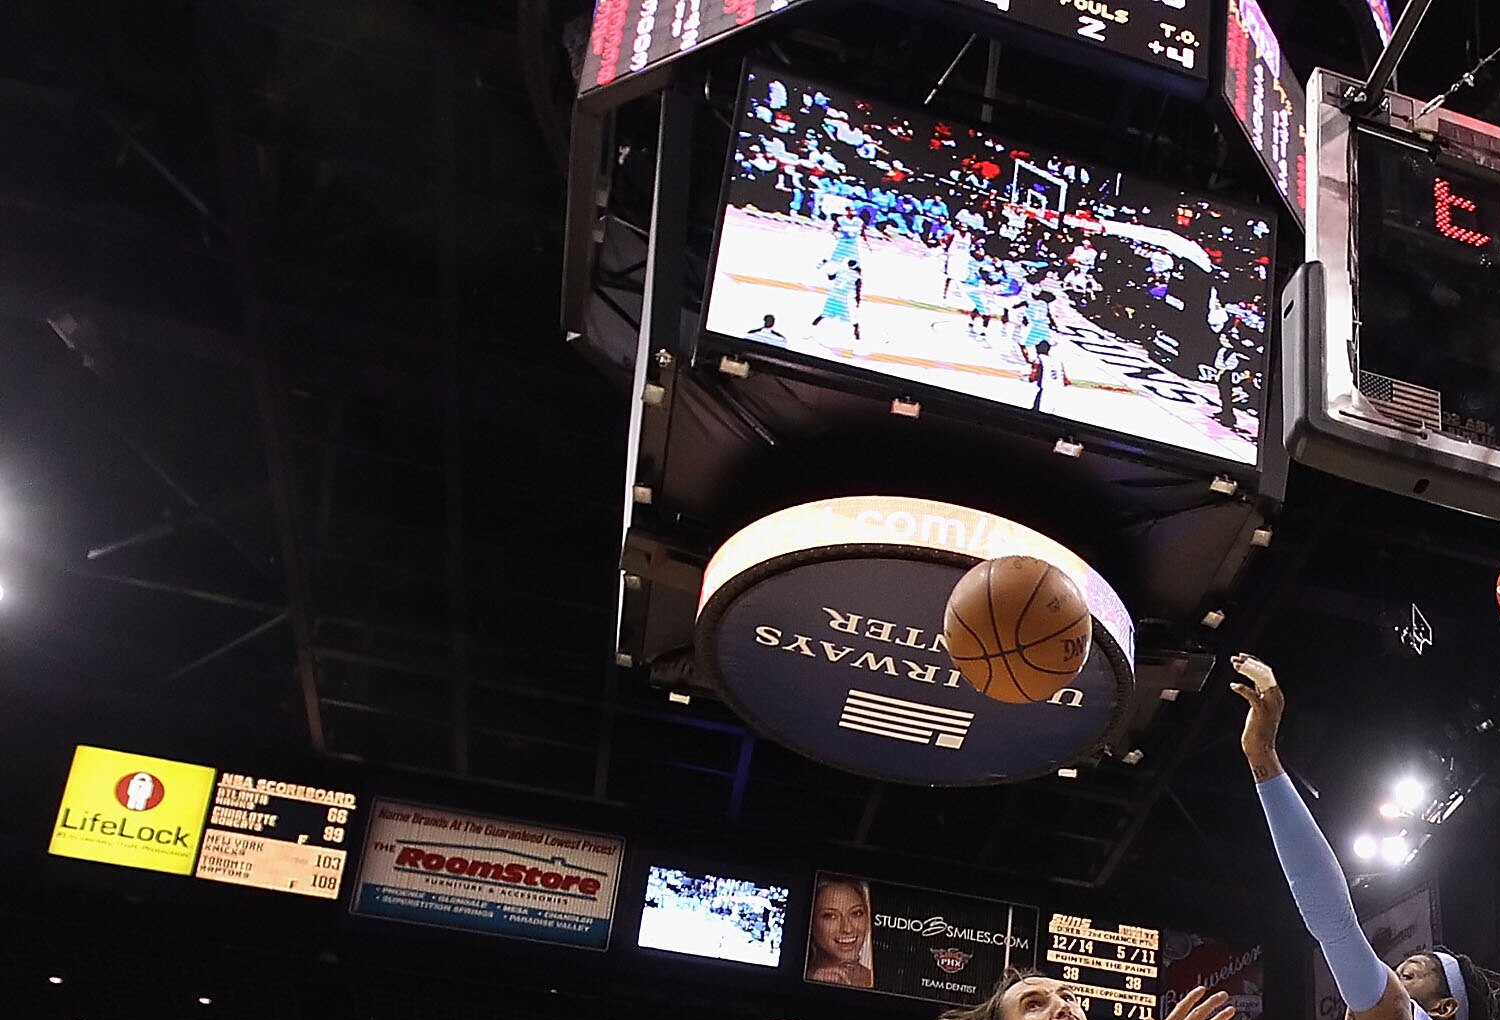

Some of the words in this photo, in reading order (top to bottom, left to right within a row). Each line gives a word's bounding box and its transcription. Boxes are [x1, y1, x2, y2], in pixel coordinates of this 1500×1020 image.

[1077, 15, 1107, 42] 2
[755, 624, 960, 690] IRWAYS
[60, 806, 192, 849] LifeLock
[396, 845, 602, 896] RoomStore
[921, 977, 945, 990] TEAM
[945, 981, 977, 995] DENTIST
